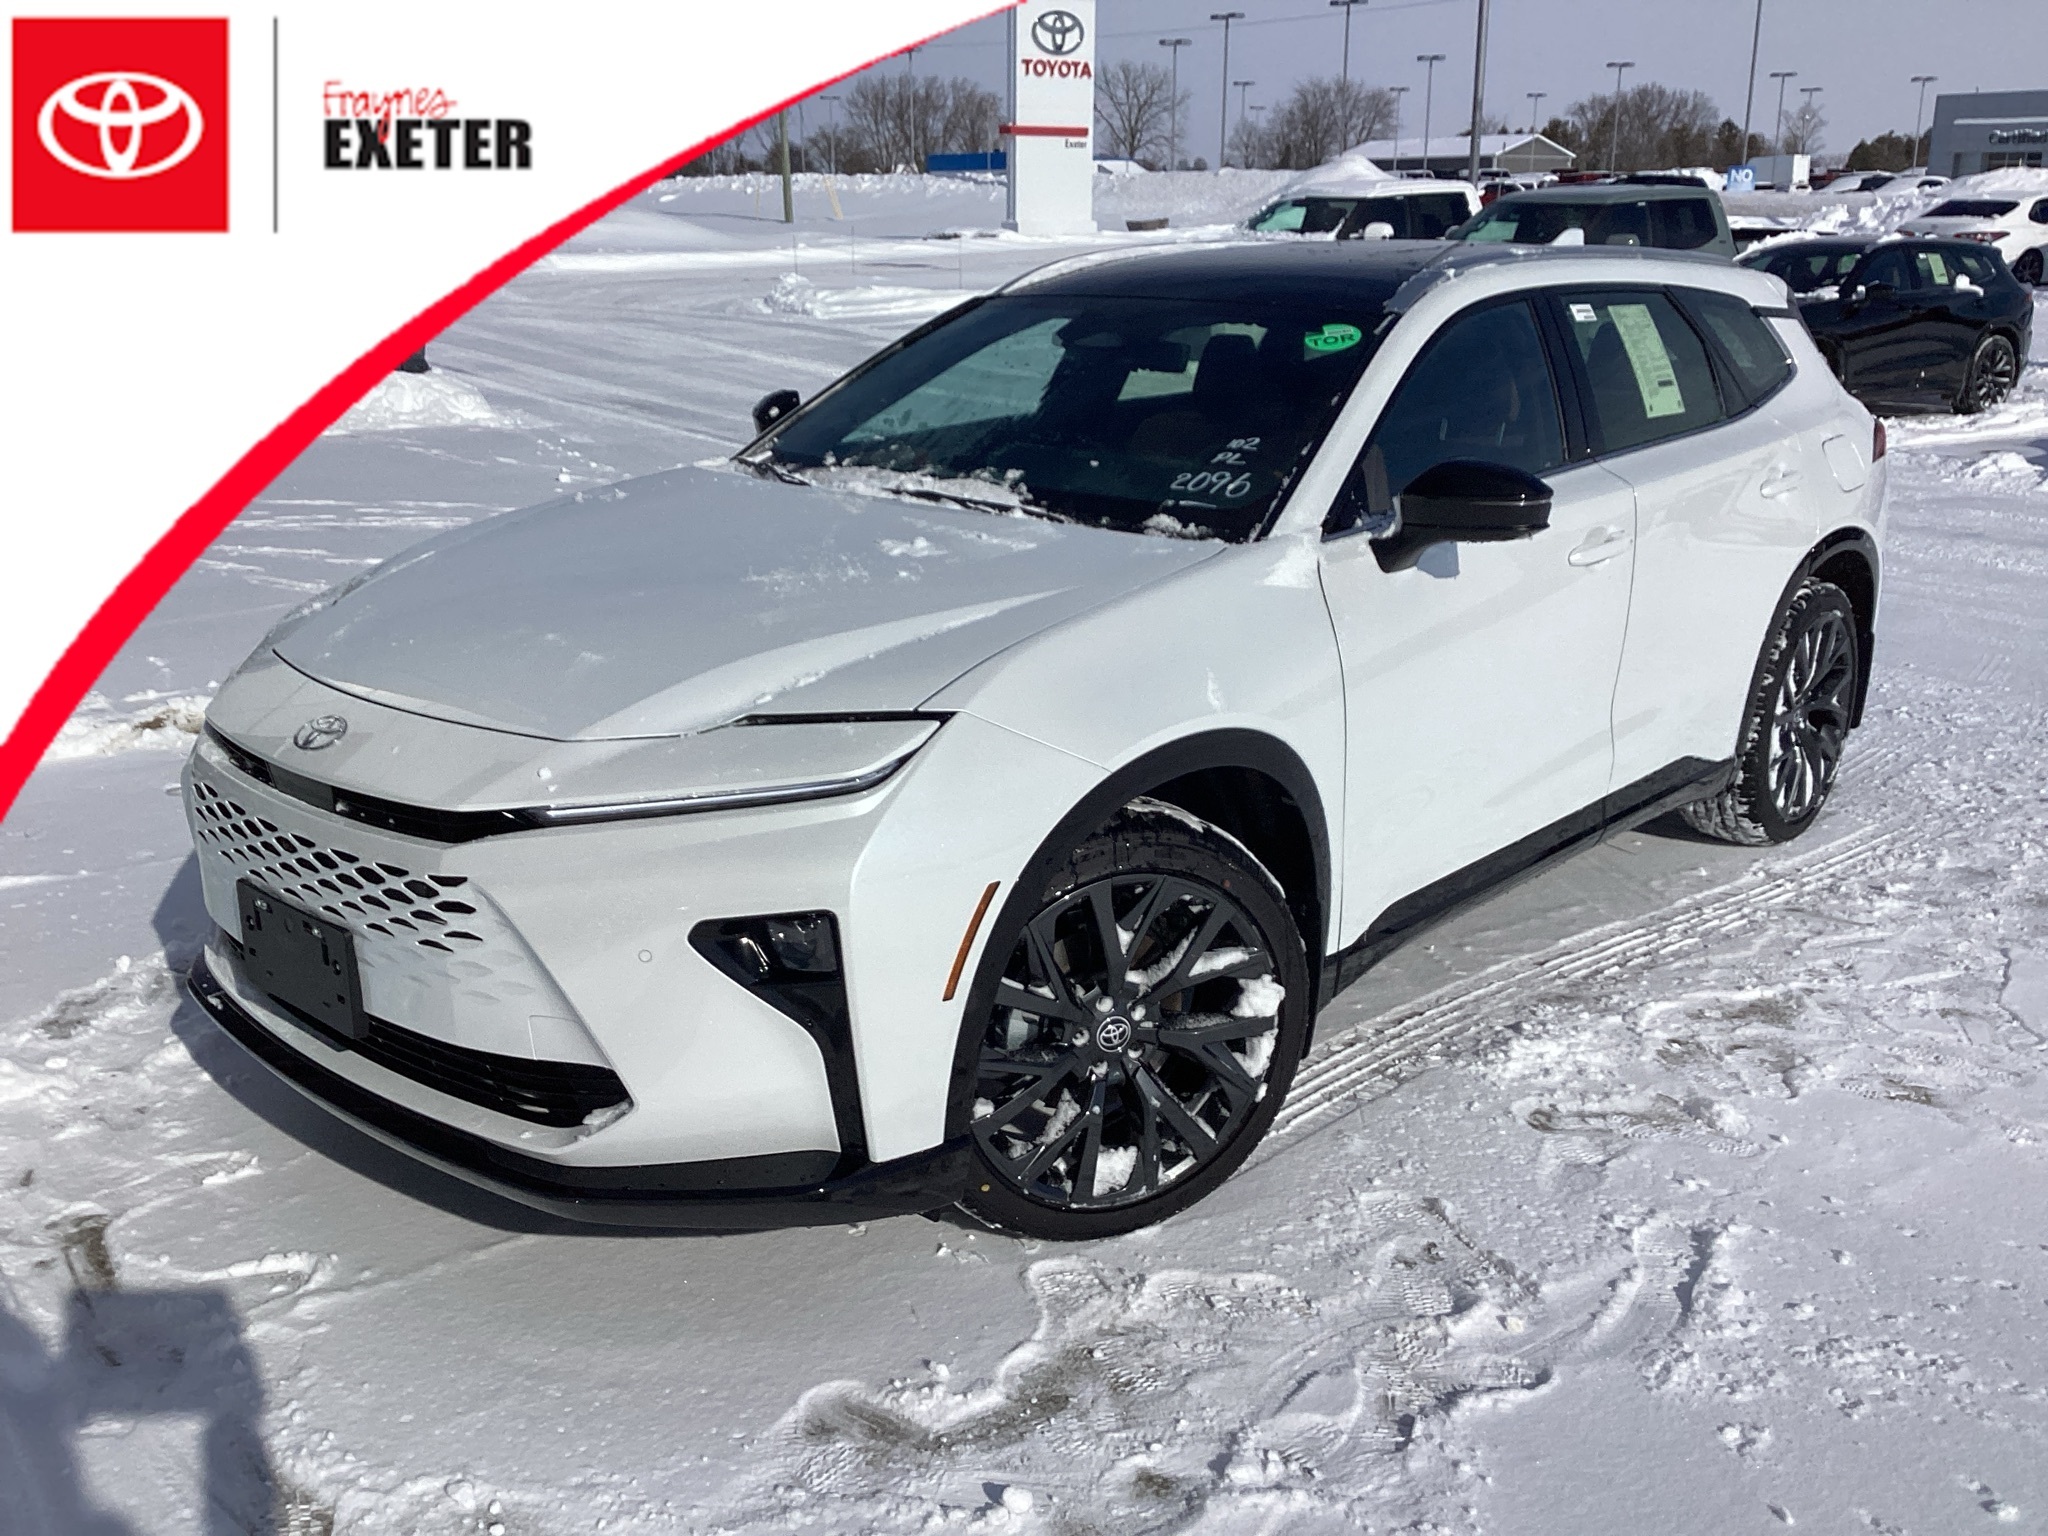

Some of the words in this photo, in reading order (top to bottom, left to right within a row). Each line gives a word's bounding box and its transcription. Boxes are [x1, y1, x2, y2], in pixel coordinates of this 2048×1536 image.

[1021, 58, 1093, 79] TOYOTA
[1730, 168, 1754, 182] NO
[1308, 333, 1356, 347] TOR
[1169, 471, 1252, 498] 2096
